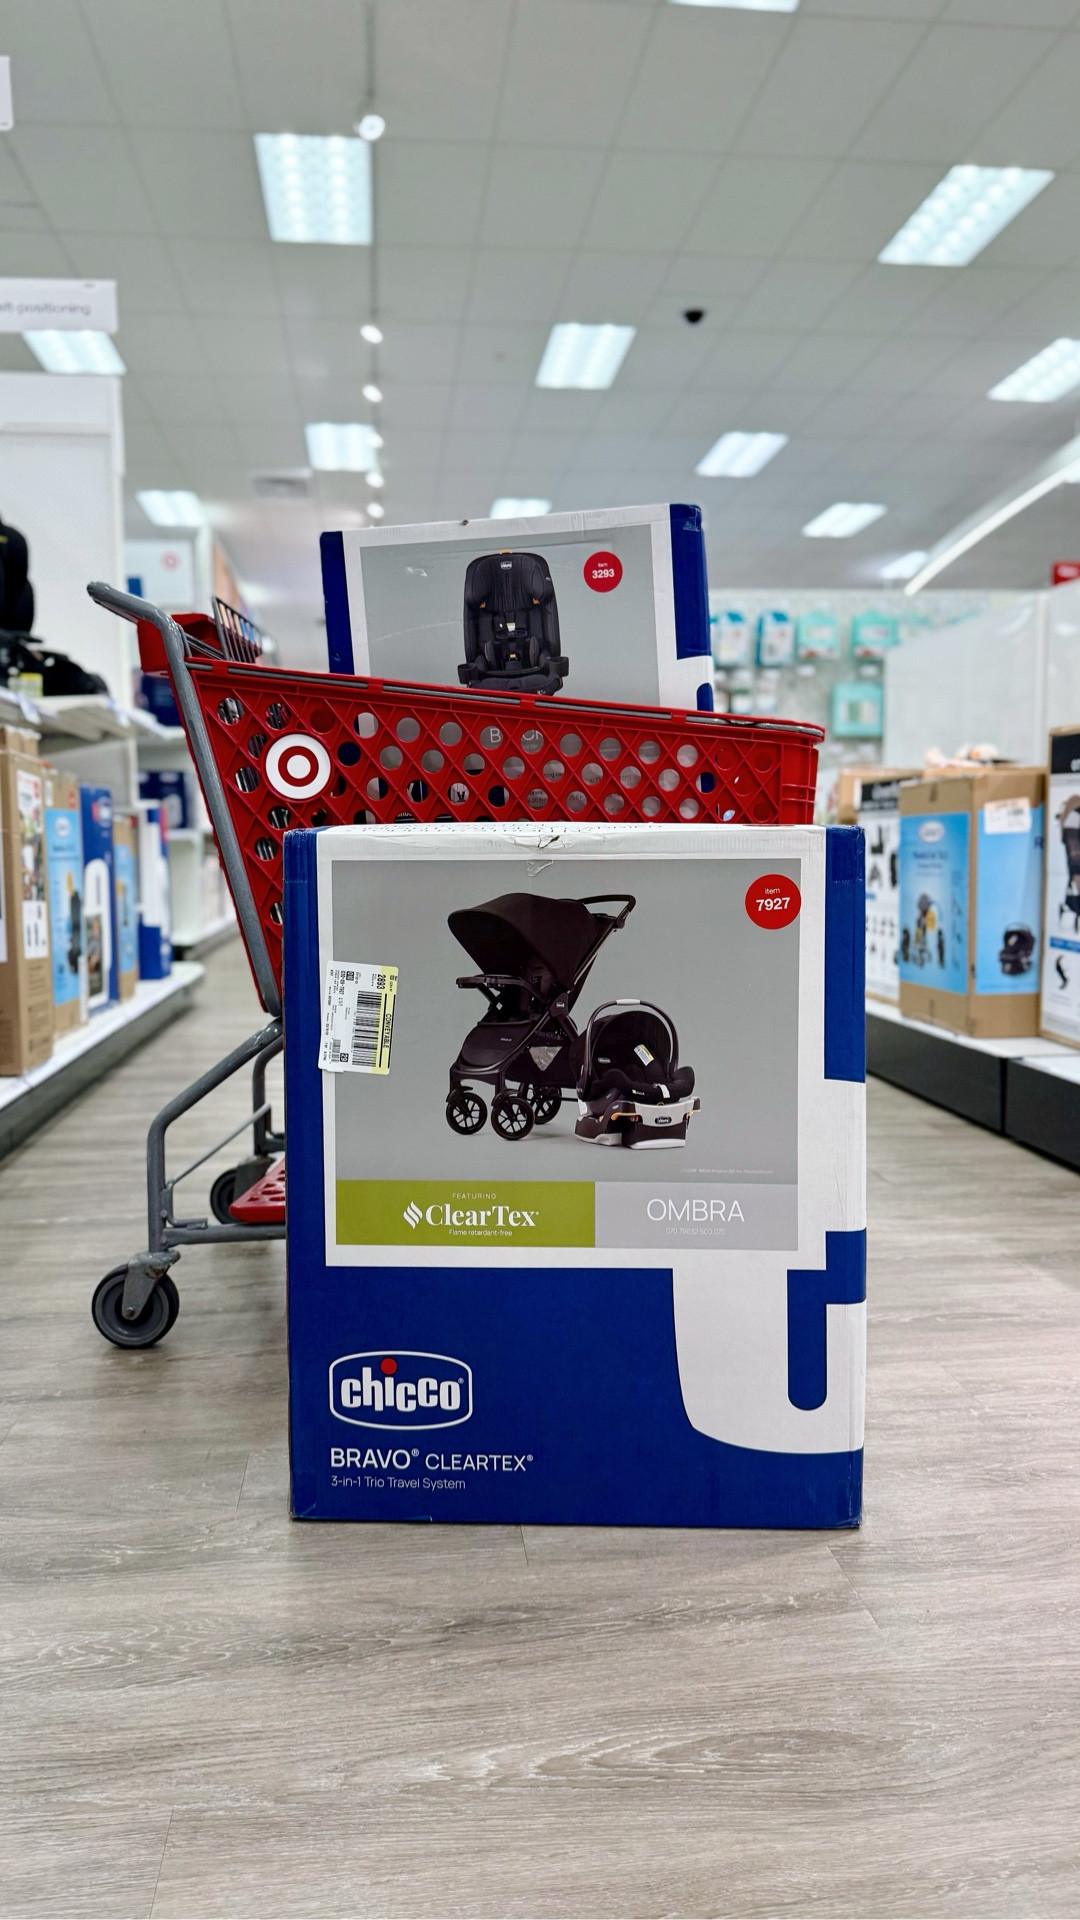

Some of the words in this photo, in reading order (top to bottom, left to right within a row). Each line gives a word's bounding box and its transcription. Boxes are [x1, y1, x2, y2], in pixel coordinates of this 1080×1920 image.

[592, 568, 615, 579] 3293
[756, 897, 790, 911] 7927
[376, 974, 386, 990] 2893
[383, 1013, 392, 1049] CONVEYABLE
[425, 1203, 540, 1227] ClearTex
[646, 1198, 745, 1222] OMBRA
[331, 1475, 361, 1487] 3-in-1
[364, 1475, 385, 1488] Trio
[387, 1476, 420, 1489] Travel
[422, 1477, 466, 1491] System
